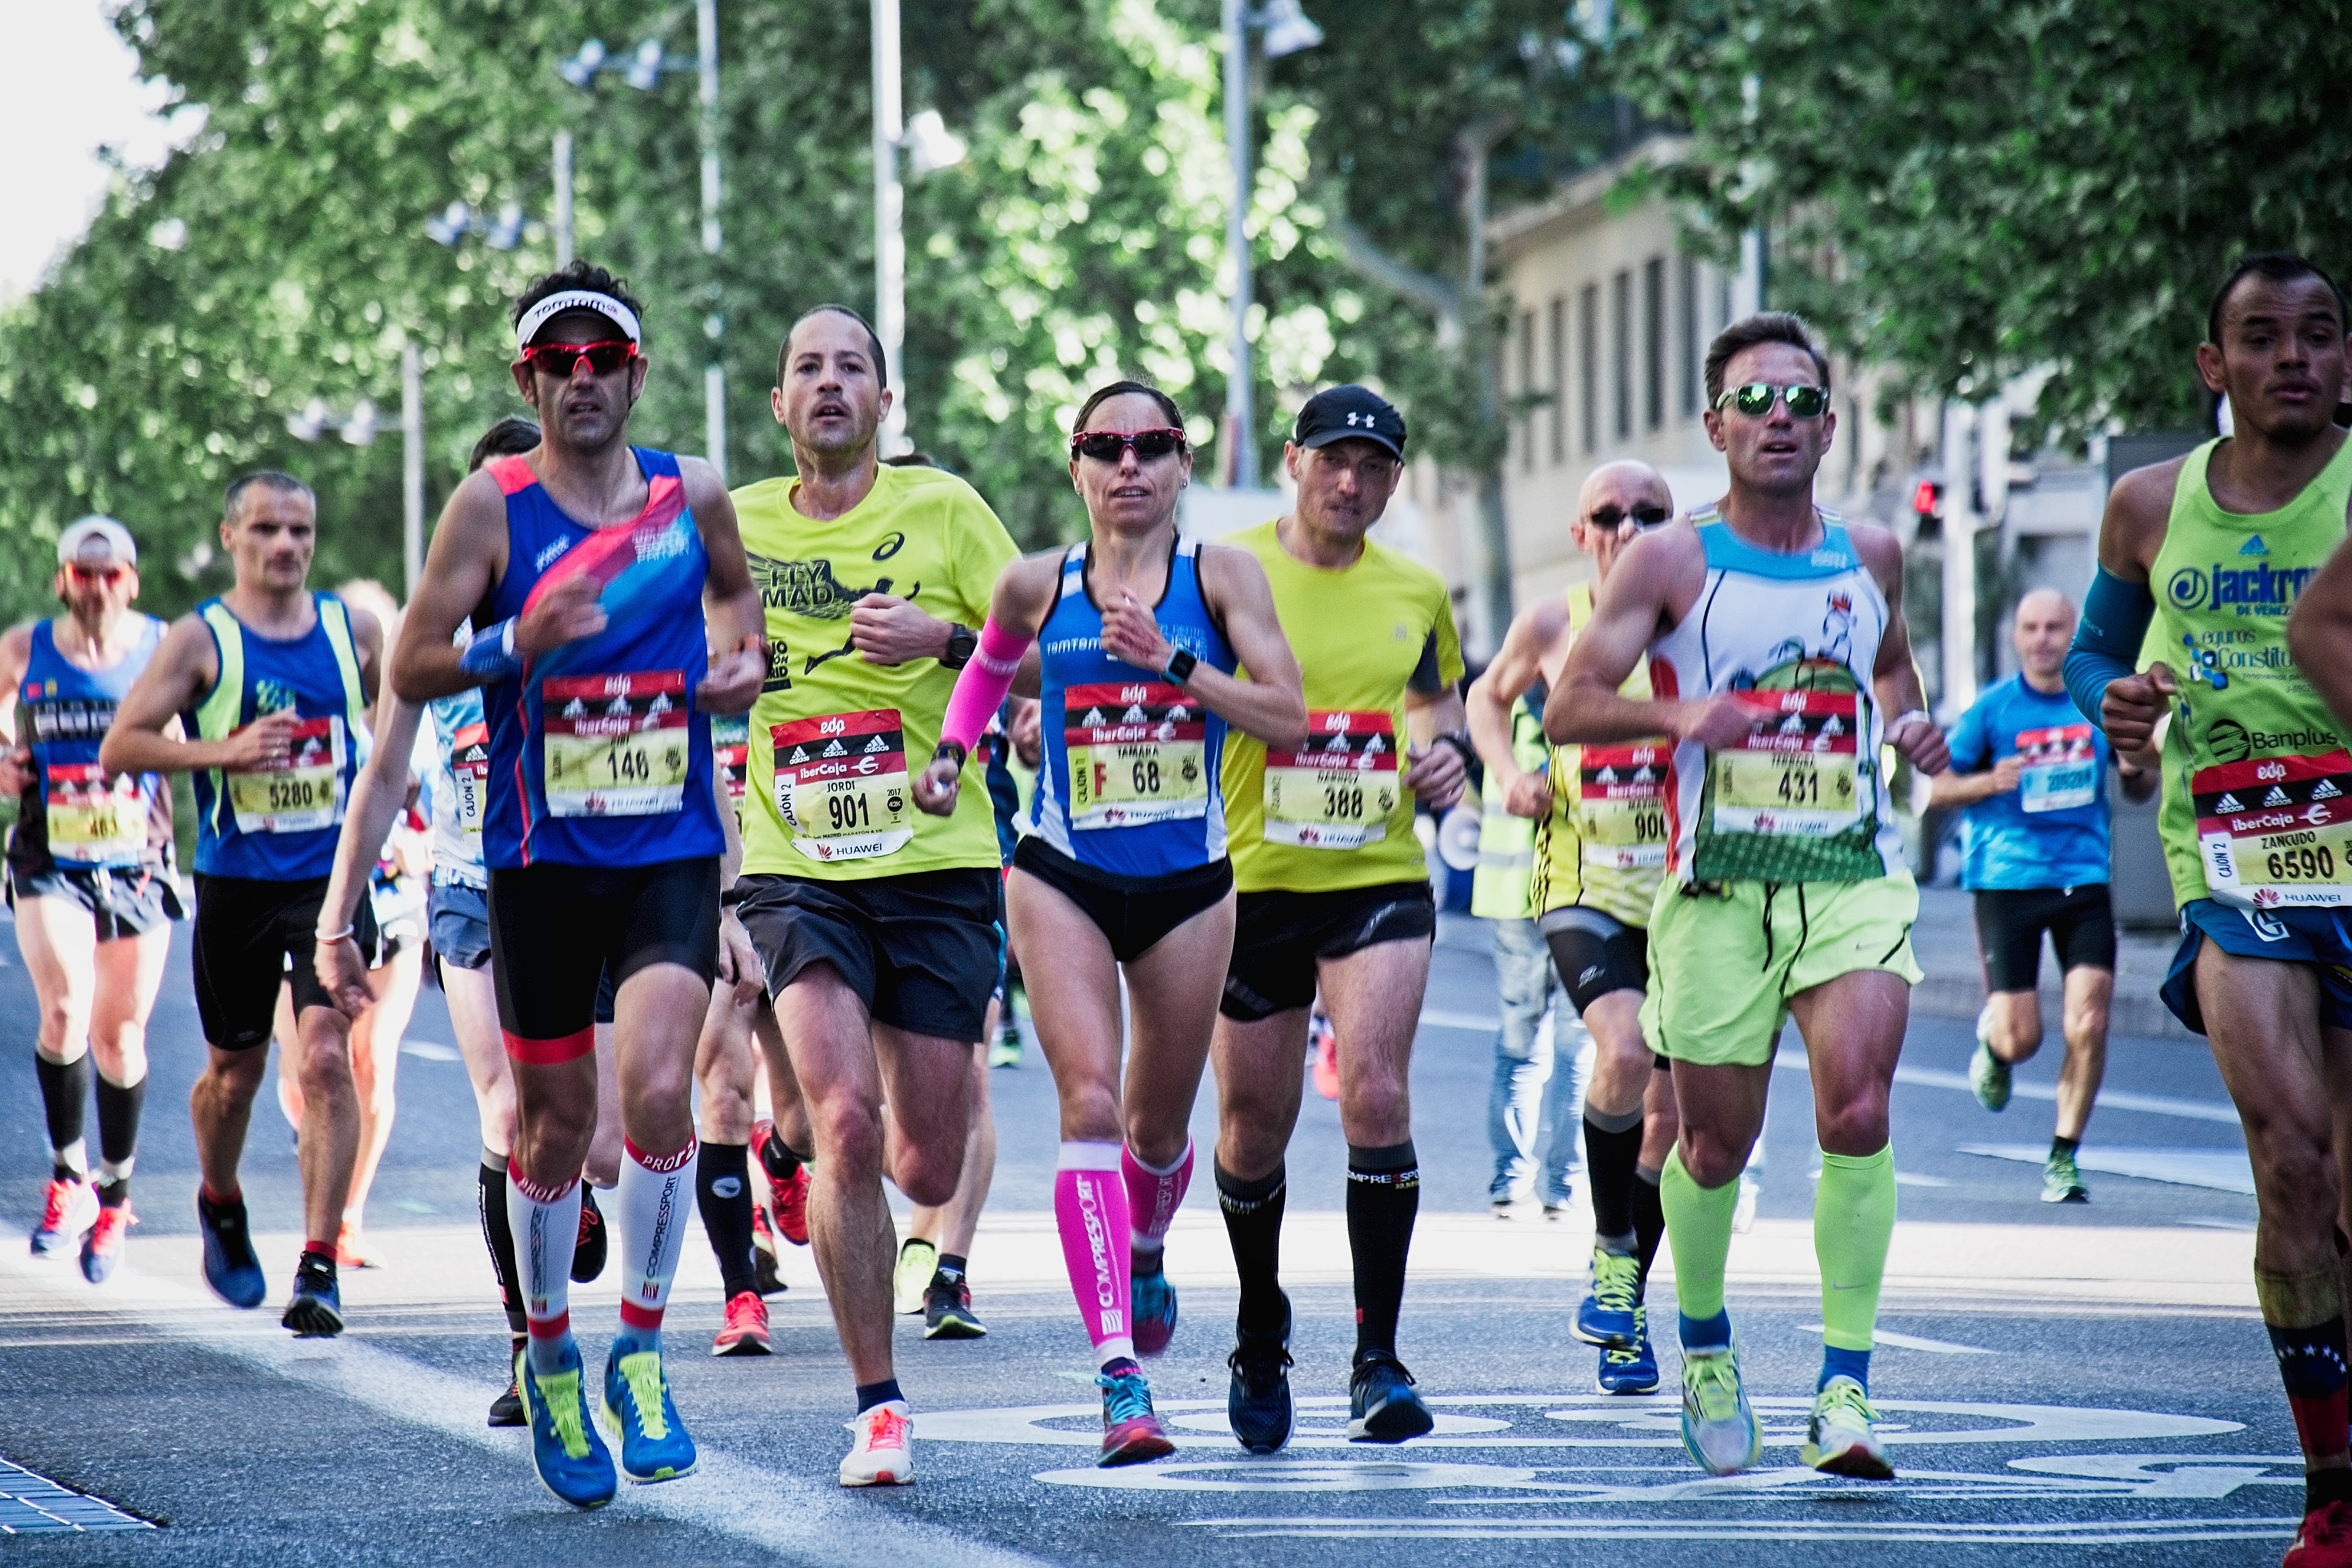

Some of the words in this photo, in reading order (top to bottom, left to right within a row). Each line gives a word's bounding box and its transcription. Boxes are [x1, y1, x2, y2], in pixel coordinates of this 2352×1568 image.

[762, 587, 834, 608] MAD
[821, 717, 845, 736] edp
[864, 745, 889, 753] adidas
[2251, 728, 2339, 749] Banplus
[789, 756, 809, 765] adidas
[822, 749, 847, 758] adidas
[800, 762, 847, 779] iberCaja
[1094, 762, 1106, 797] F
[1132, 760, 1160, 793] 68
[2257, 761, 2287, 782] edp
[270, 782, 312, 809] 5280
[827, 781, 855, 793] JORDI
[887, 788, 901, 796] 2017
[1778, 770, 1818, 804] 431
[464, 786, 476, 817] CAJÓN
[780, 794, 797, 827] CAJÓN
[829, 793, 870, 830] 901
[1323, 786, 1362, 818] 388
[836, 843, 882, 855] HUAWEI
[2261, 831, 2316, 850] ZANCUDO
[2217, 852, 2233, 878] CAJÓN
[2268, 845, 2335, 880] 6590
[2285, 894, 2341, 902] HUAWEI
[646, 1176, 676, 1278] COMPRESSPORT
[1076, 1174, 1114, 1308] COMPRESSPORT
